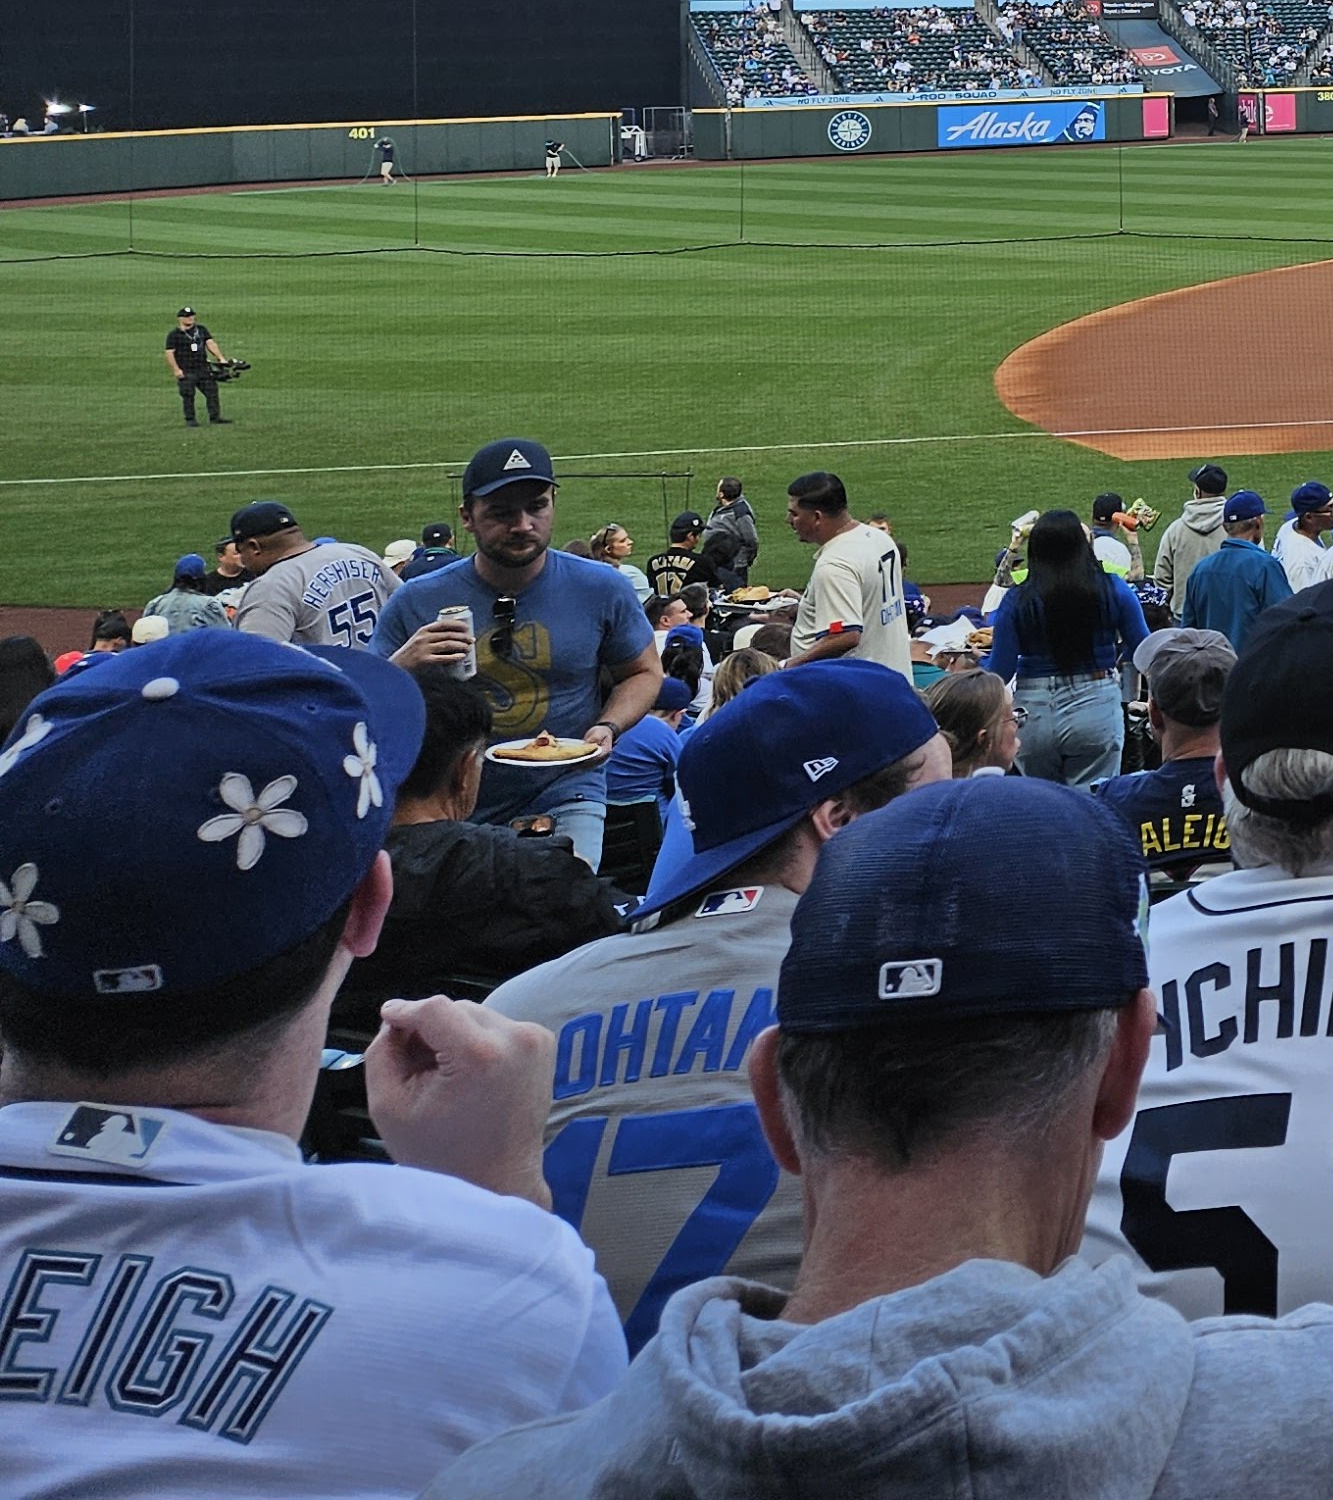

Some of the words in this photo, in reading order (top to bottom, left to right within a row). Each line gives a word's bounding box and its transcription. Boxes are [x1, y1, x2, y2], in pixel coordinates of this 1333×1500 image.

[349, 126, 376, 140] 401
[947, 111, 1052, 141] Alaska
[303, 559, 381, 611] HERSHISER
[877, 549, 897, 603] 17
[327, 588, 378, 649] 55
[542, 1101, 781, 1362] 17
